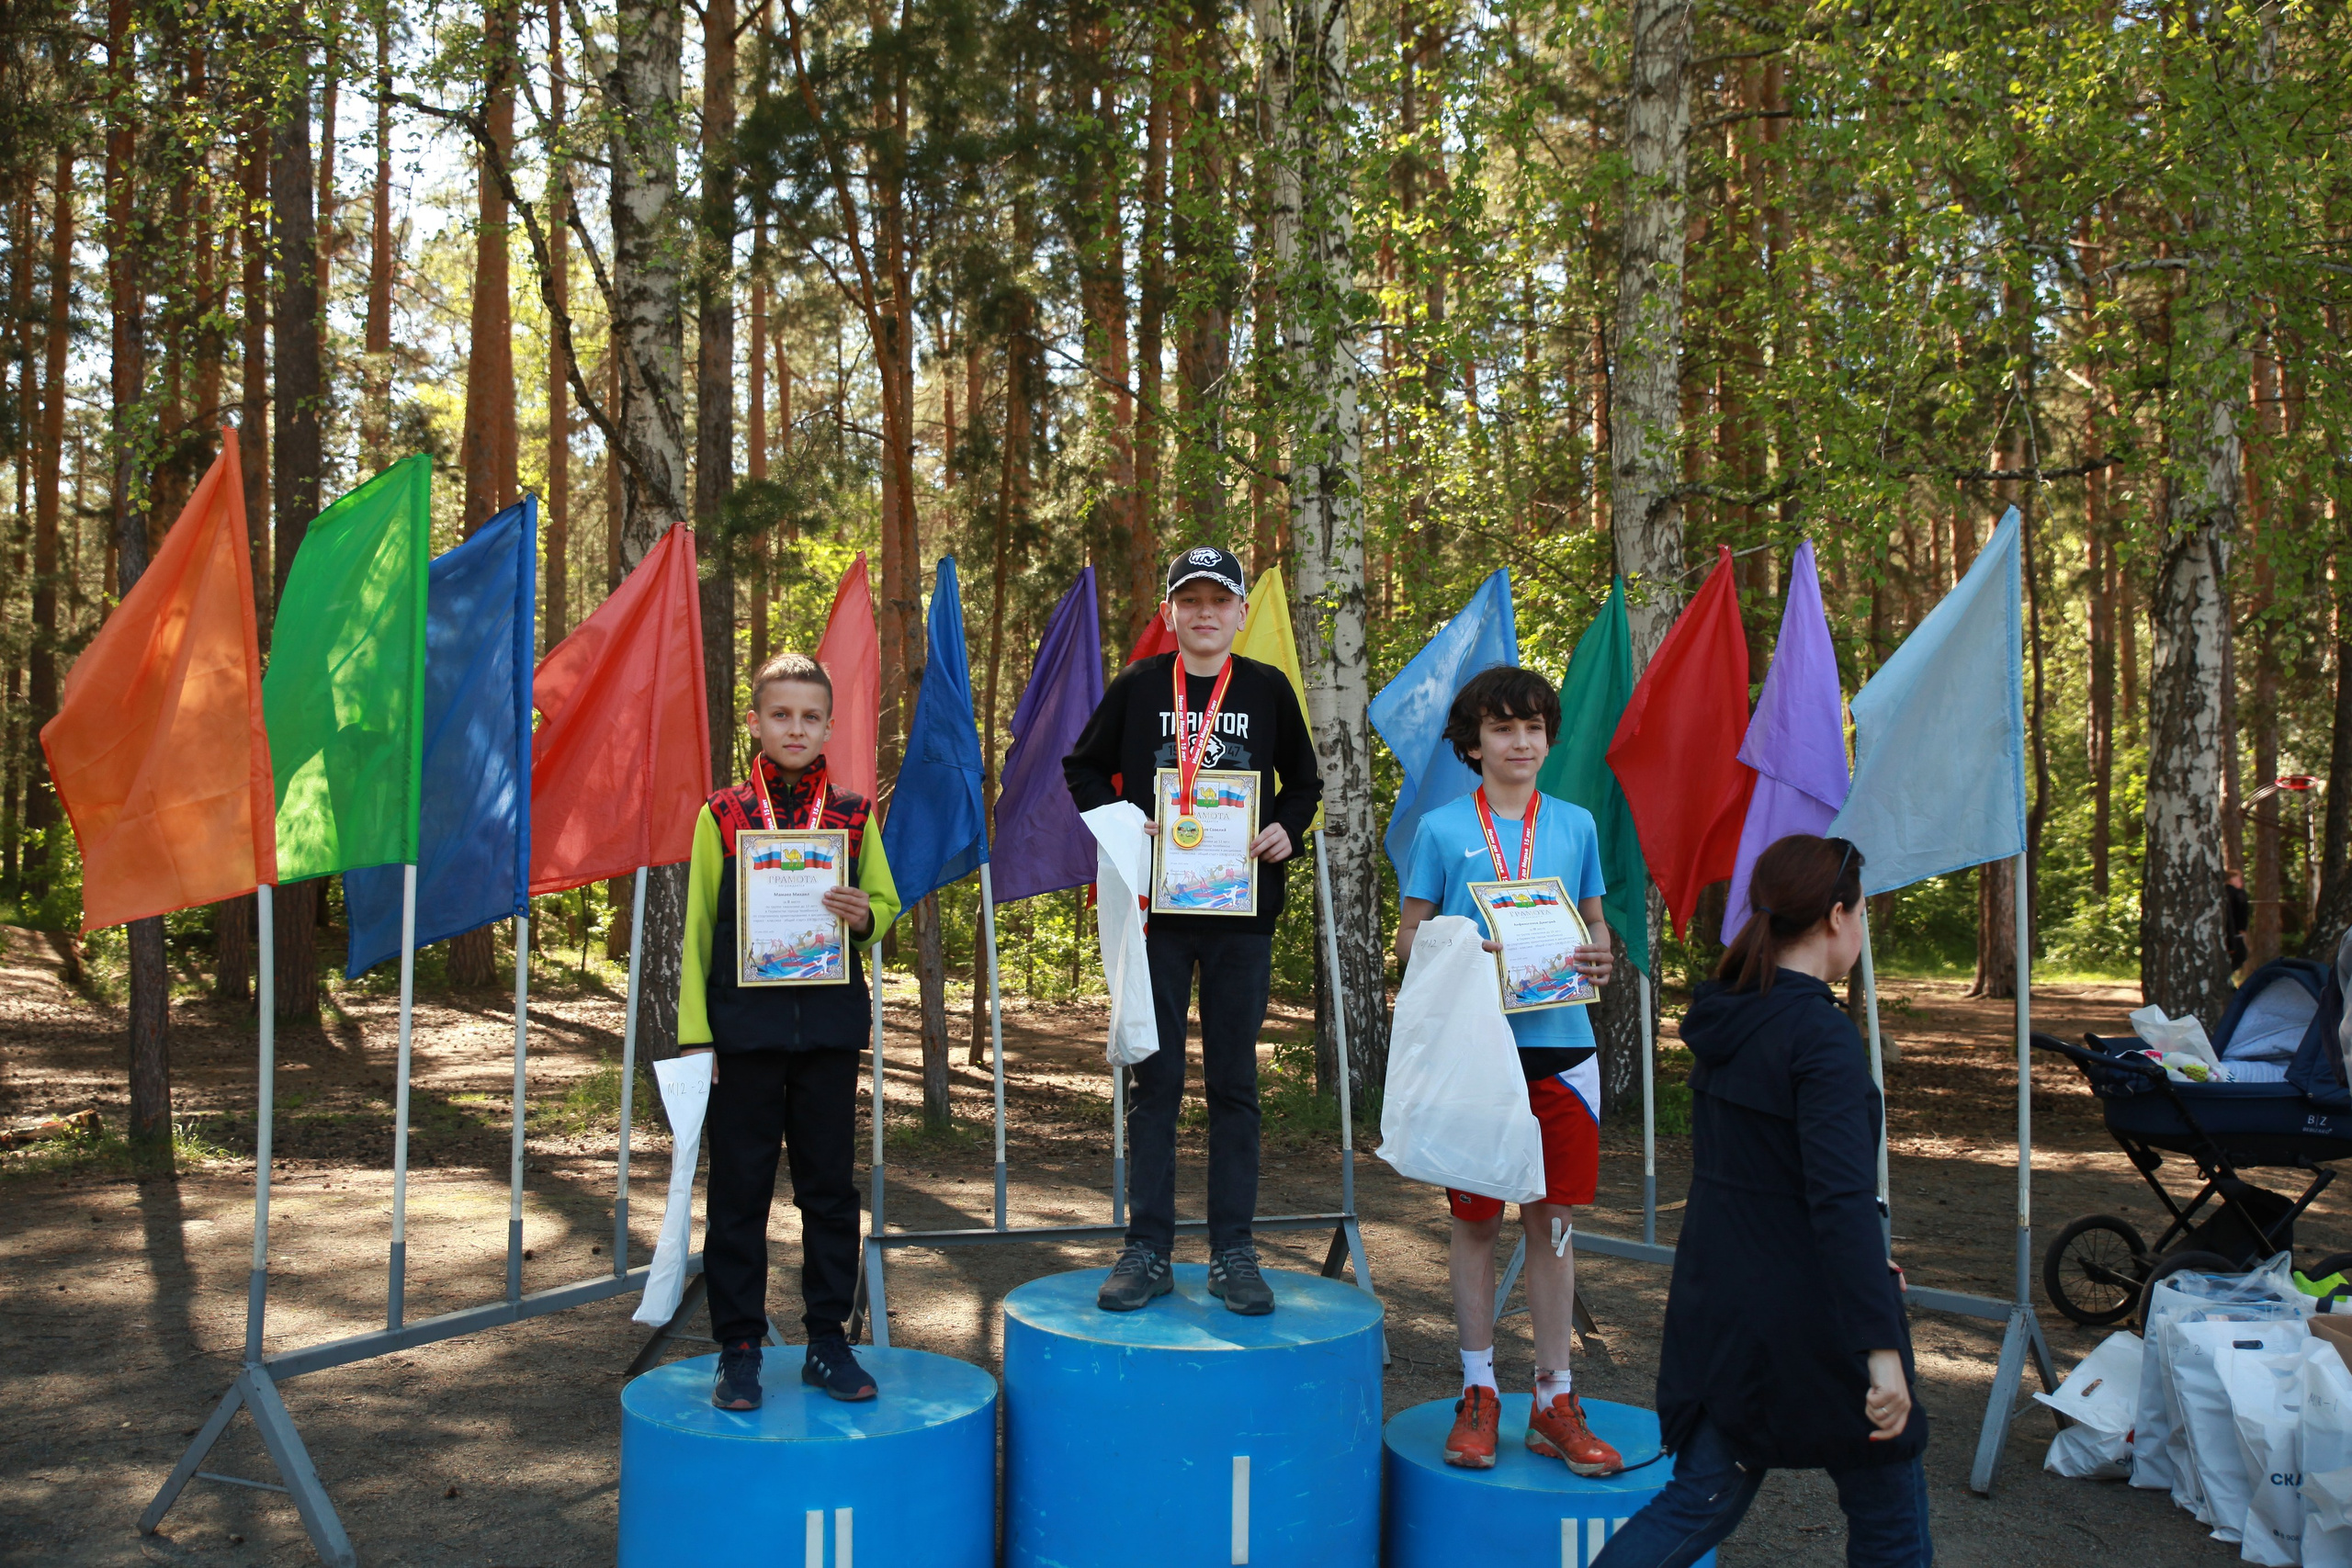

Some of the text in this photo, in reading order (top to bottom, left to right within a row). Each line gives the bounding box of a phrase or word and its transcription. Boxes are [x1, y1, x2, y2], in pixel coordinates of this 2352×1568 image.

[1227, 746, 1240, 757] 47
[812, 807, 819, 815] 15
[1495, 852, 1504, 873] Марья
[1510, 909, 1551, 918] ГРАМОТА
